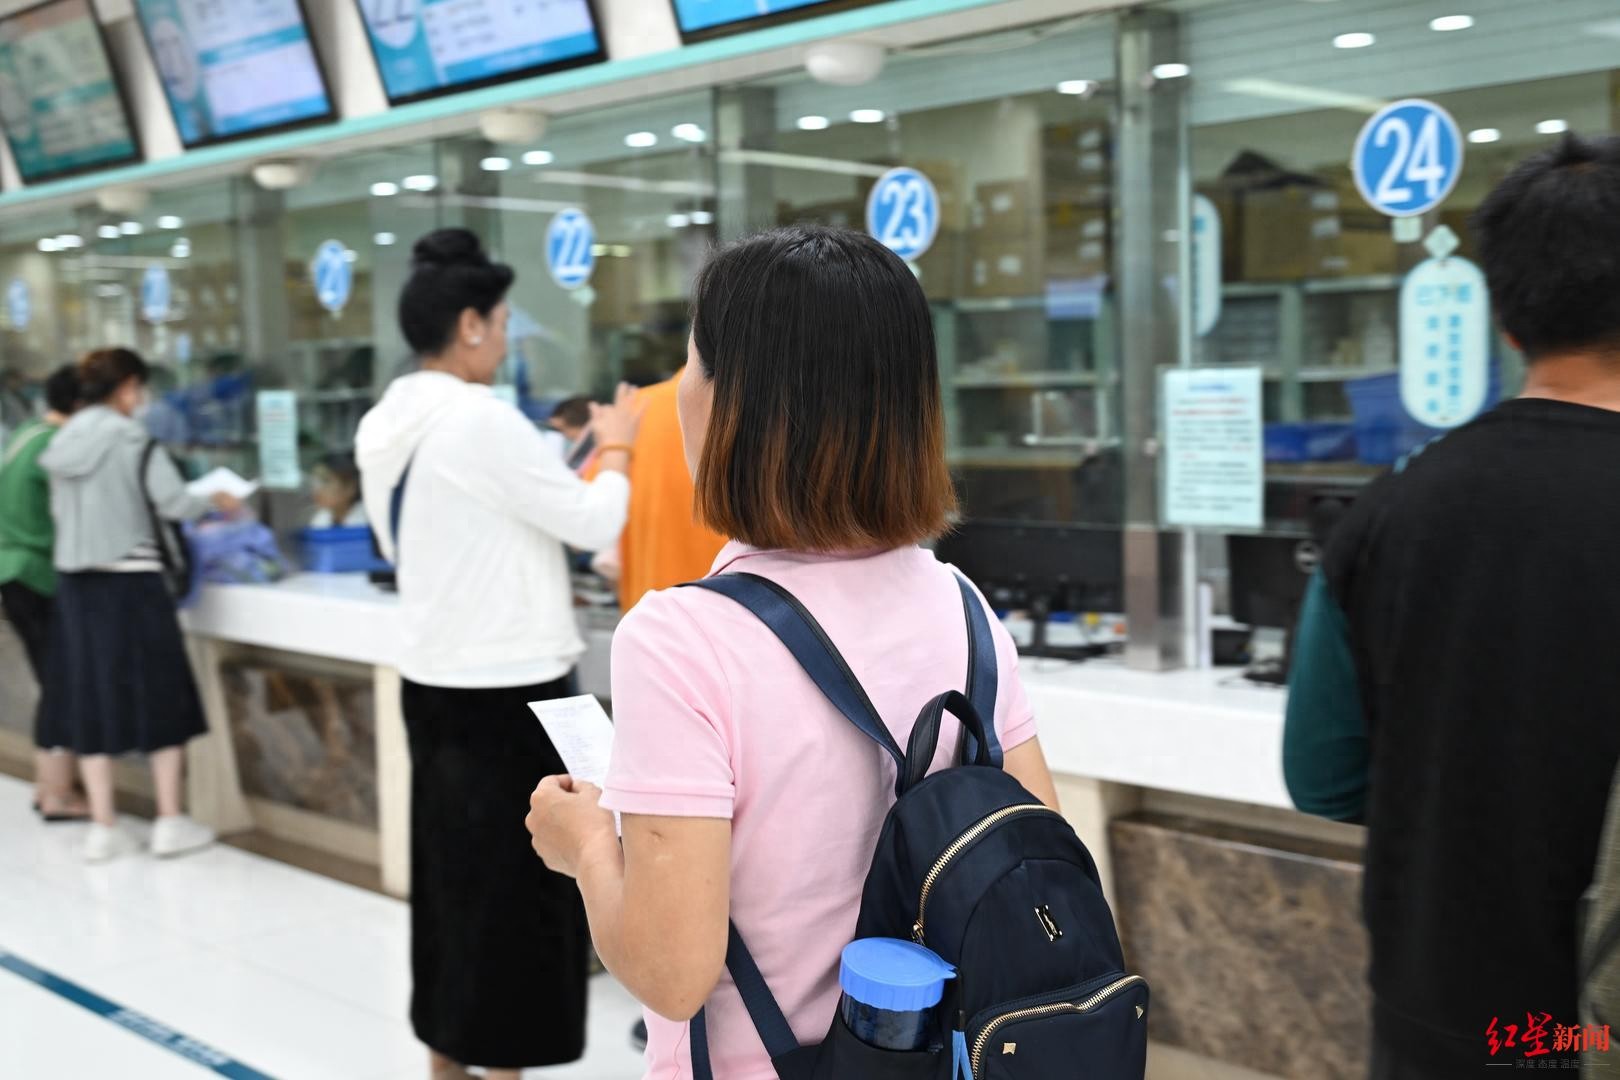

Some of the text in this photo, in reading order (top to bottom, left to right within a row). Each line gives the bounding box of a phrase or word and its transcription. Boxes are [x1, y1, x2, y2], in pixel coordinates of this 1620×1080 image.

[1373, 112, 1446, 204] 24
[554, 218, 591, 276] 22
[880, 180, 928, 251] 23
